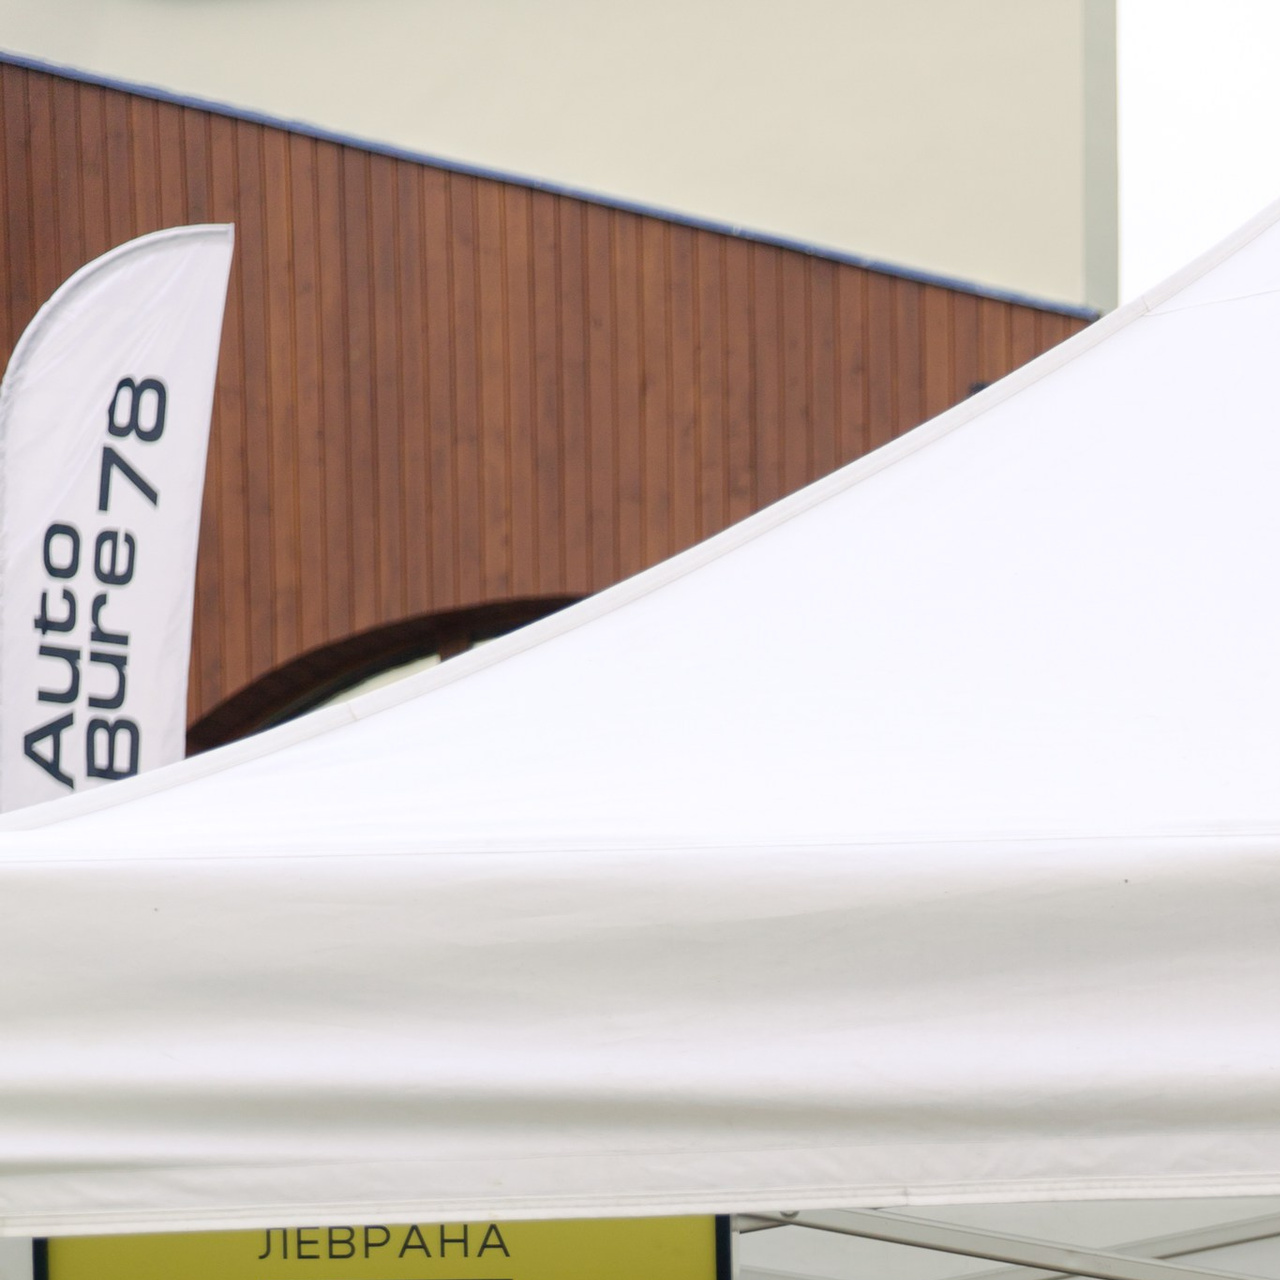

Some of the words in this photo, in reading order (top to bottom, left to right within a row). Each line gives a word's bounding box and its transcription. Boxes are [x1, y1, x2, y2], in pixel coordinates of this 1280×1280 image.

[98, 375, 168, 512] 78
[24, 522, 82, 791] Auto
[85, 527, 140, 781] Bure
[258, 1223, 511, 1260] ЛЕВРАНА
